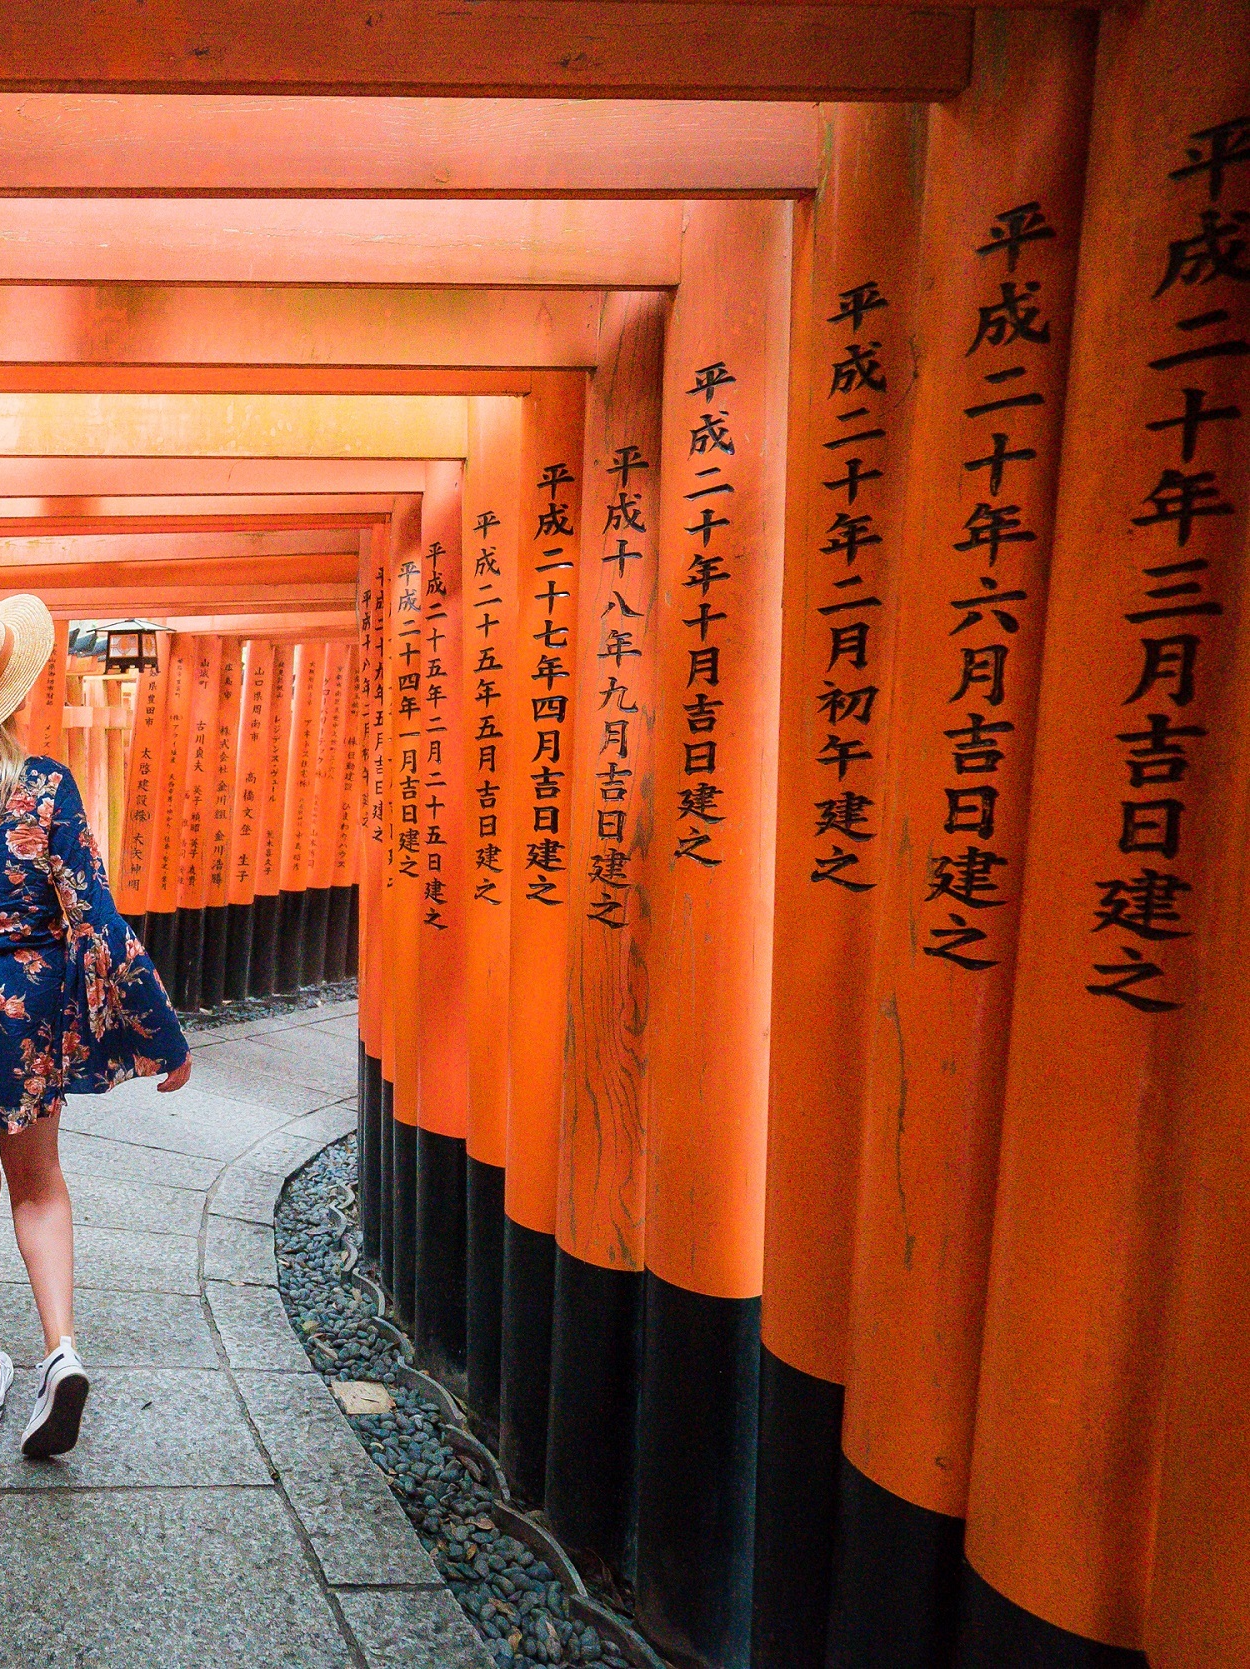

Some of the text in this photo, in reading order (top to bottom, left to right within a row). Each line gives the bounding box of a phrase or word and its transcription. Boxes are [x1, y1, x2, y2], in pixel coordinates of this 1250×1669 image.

[398, 560, 422, 879] 平成二十四年一月吉日建之
[423, 541, 448, 930] 平成二十五年二月二十五日建之
[473, 510, 504, 906] 平成二十五年五月吉日建之
[525, 462, 575, 906] 平成二十七年四月吉日建之
[587, 445, 649, 930] 平成十八年九月吉日建之
[674, 361, 737, 869] 平成二十年十月吉日建之
[810, 280, 889, 893] 平成二十年二月初午建之
[923, 201, 1057, 972] 平成二十年六月吉日建之
[1085, 116, 1250, 1014] 平成二十年三月吉日建之
